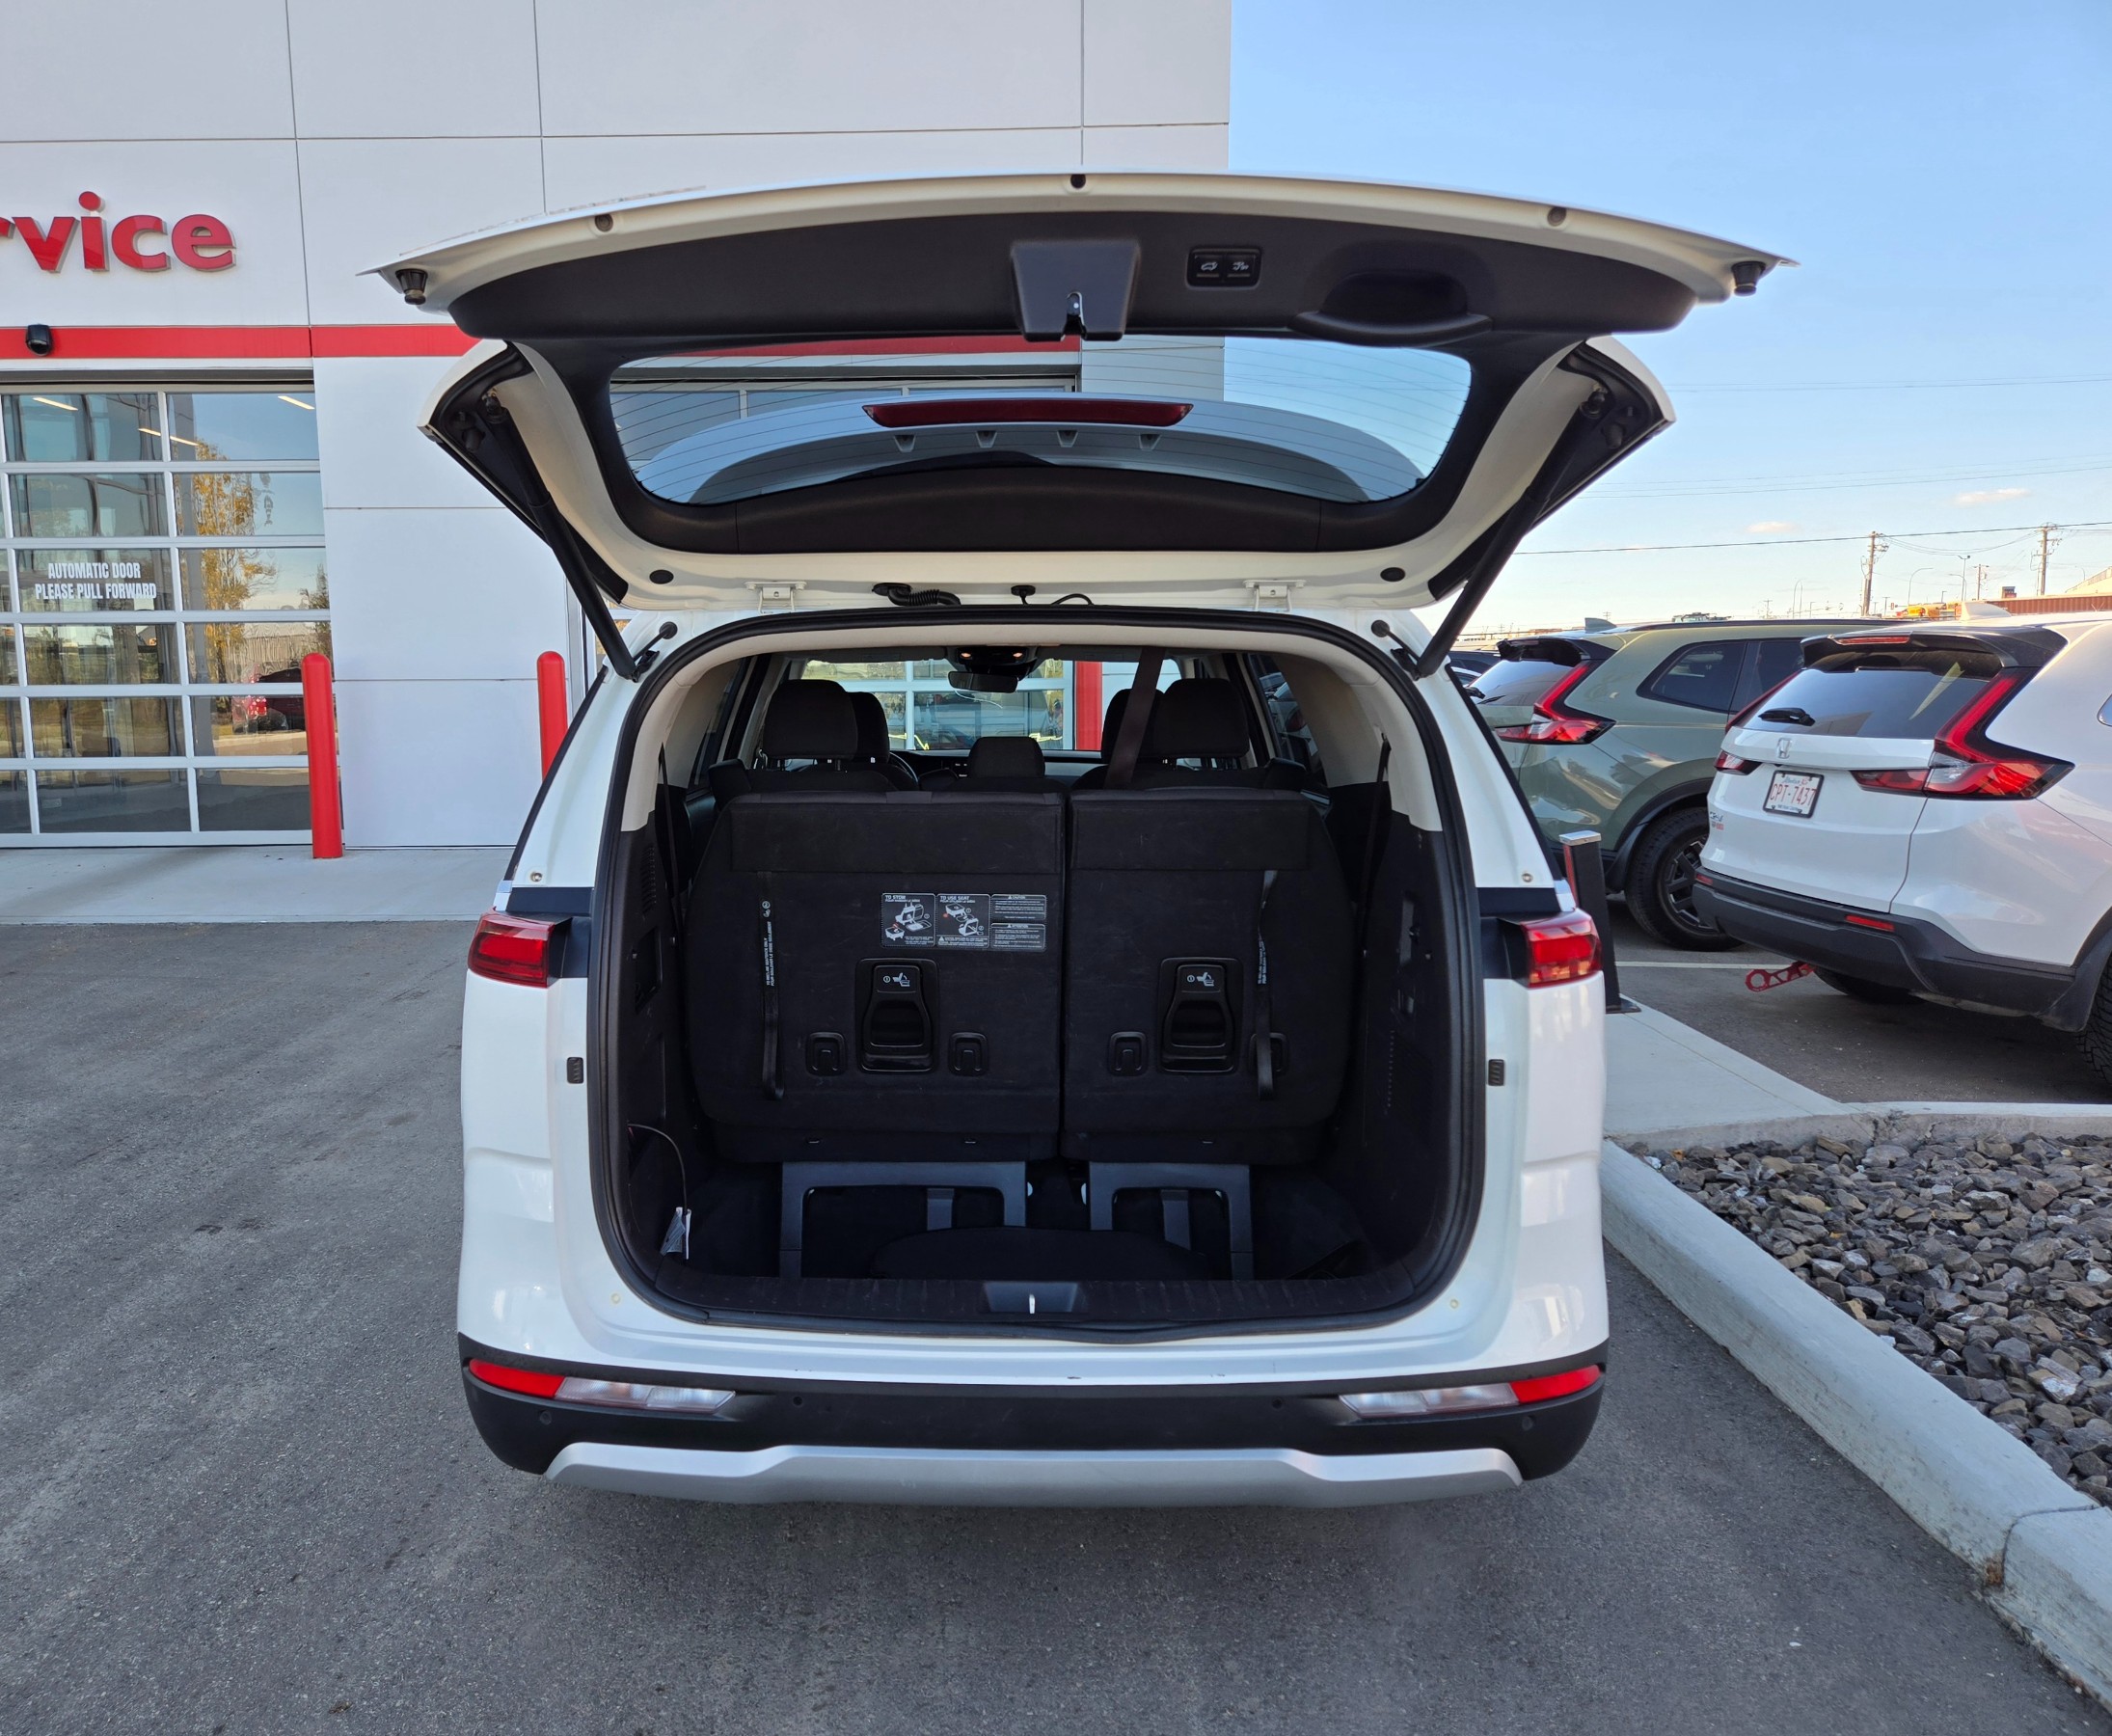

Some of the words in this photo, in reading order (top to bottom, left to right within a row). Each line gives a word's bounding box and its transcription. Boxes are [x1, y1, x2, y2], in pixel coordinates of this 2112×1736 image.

[0, 190, 235, 272] vice
[48, 562, 109, 579] AUTOMATIC
[112, 562, 141, 579] DOOR
[35, 583, 74, 599] PLEASE
[77, 583, 103, 599] PULL
[105, 583, 157, 599] FORWARD
